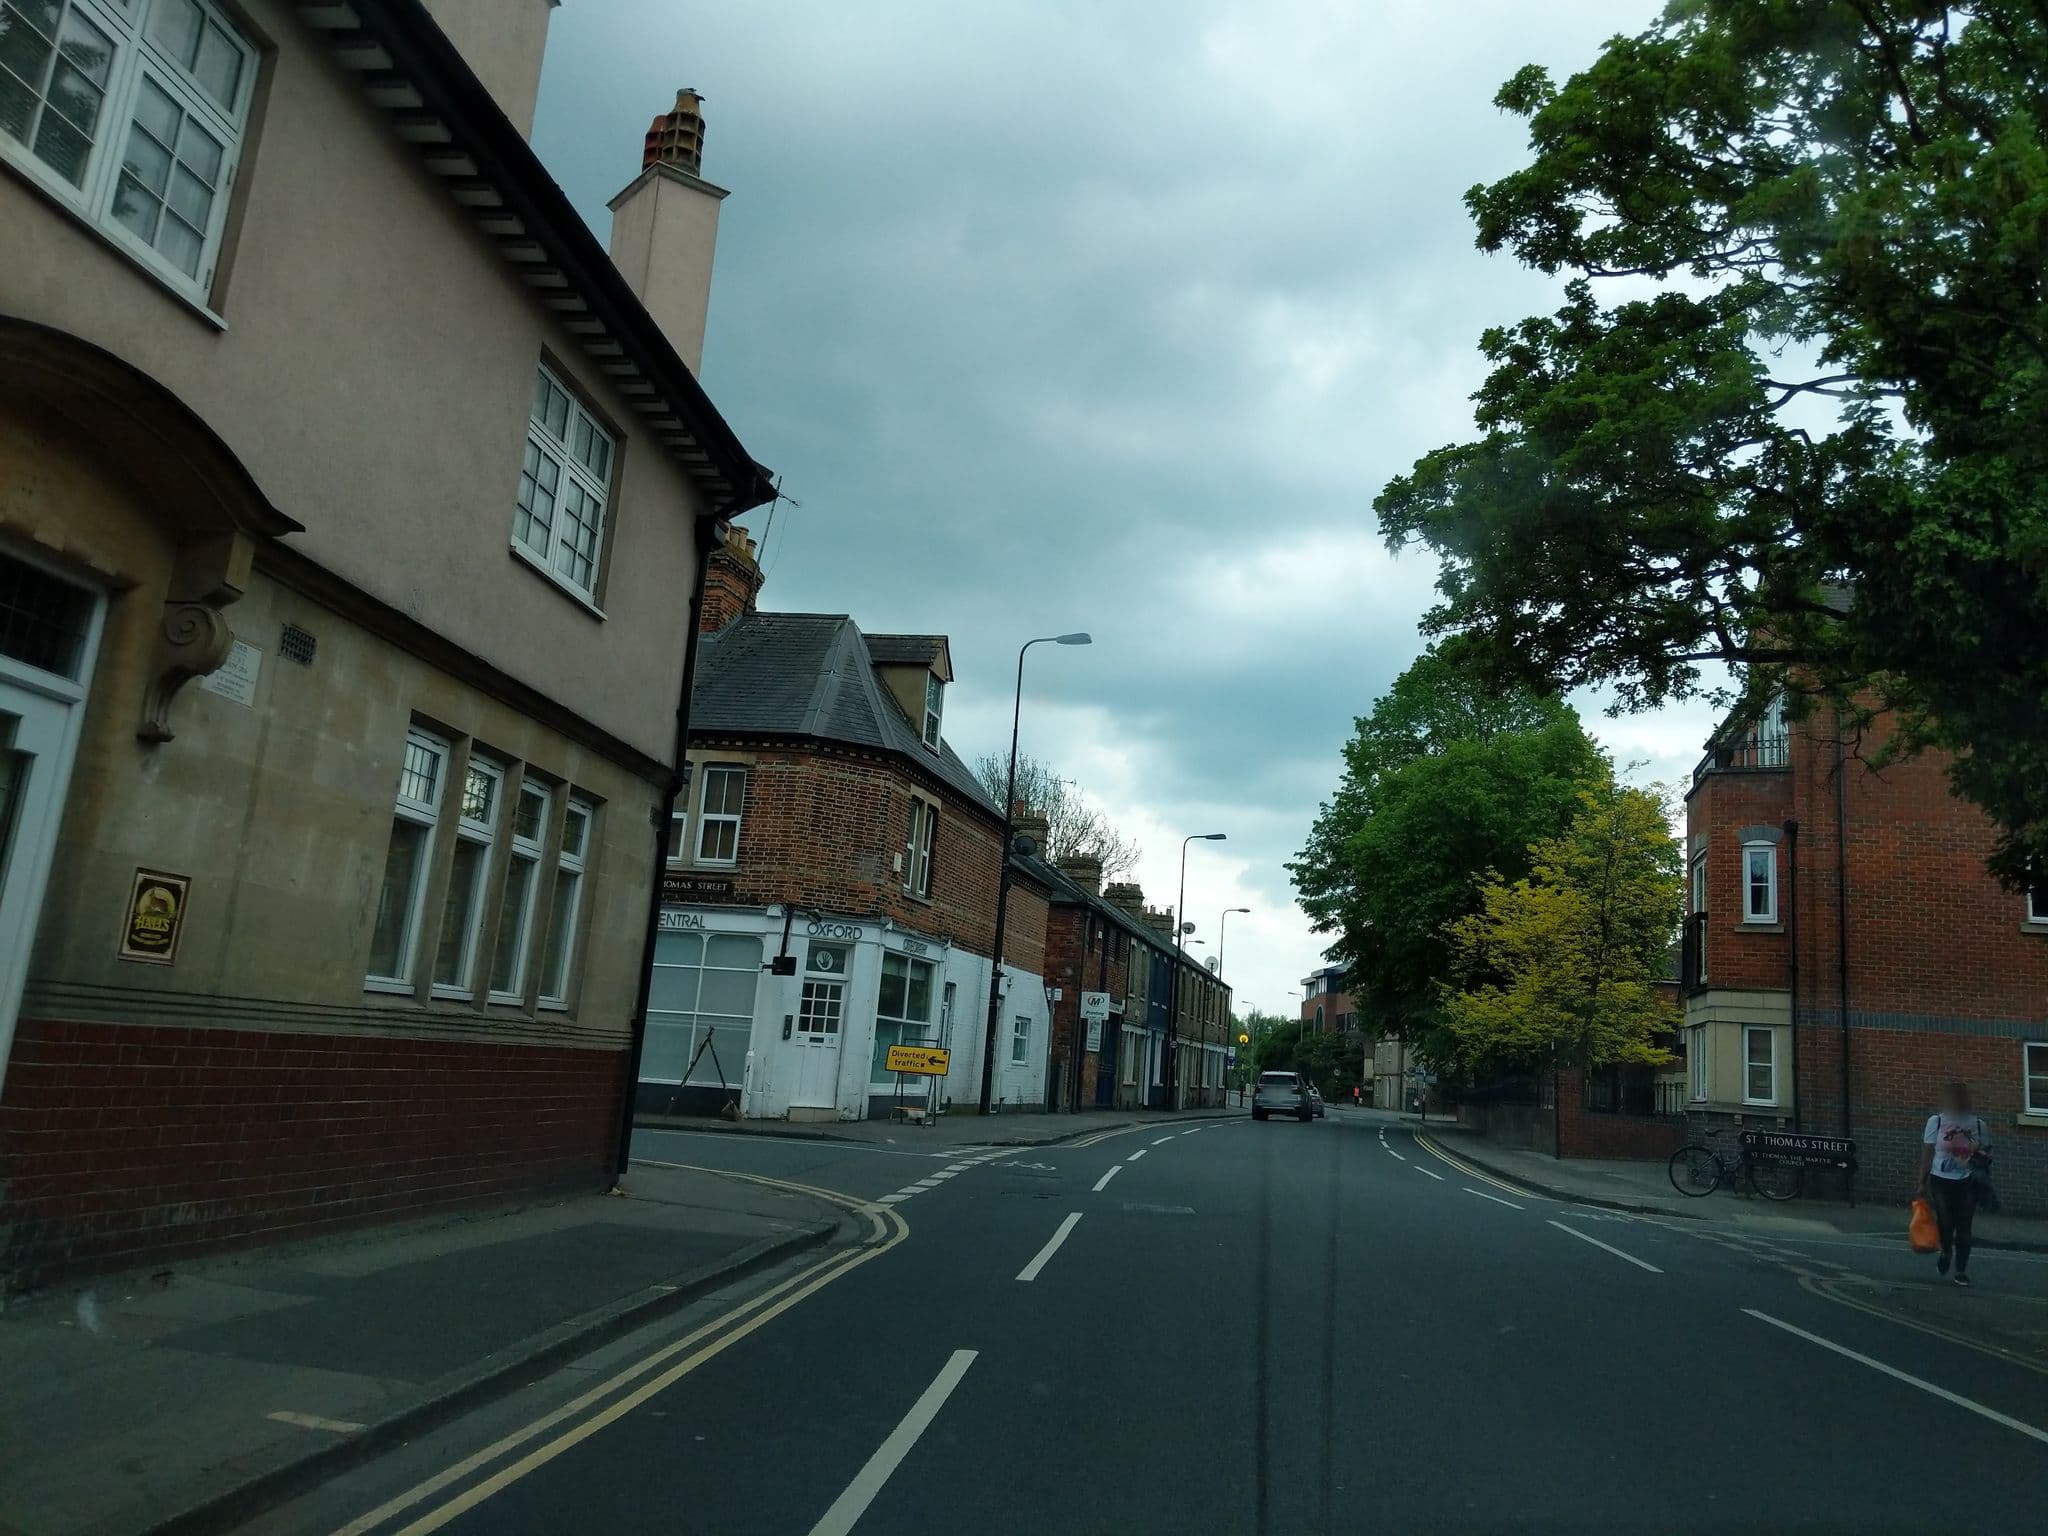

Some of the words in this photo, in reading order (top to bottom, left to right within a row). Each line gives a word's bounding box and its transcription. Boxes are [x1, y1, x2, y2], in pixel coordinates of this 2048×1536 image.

[697, 882, 728, 891] STREET
[807, 921, 863, 940] OXFORD
[892, 1050, 926, 1059] Diverted
[1745, 1134, 1757, 1145] ST
[1765, 1136, 1807, 1149] THOMAS
[1811, 1140, 1849, 1152] STREET
